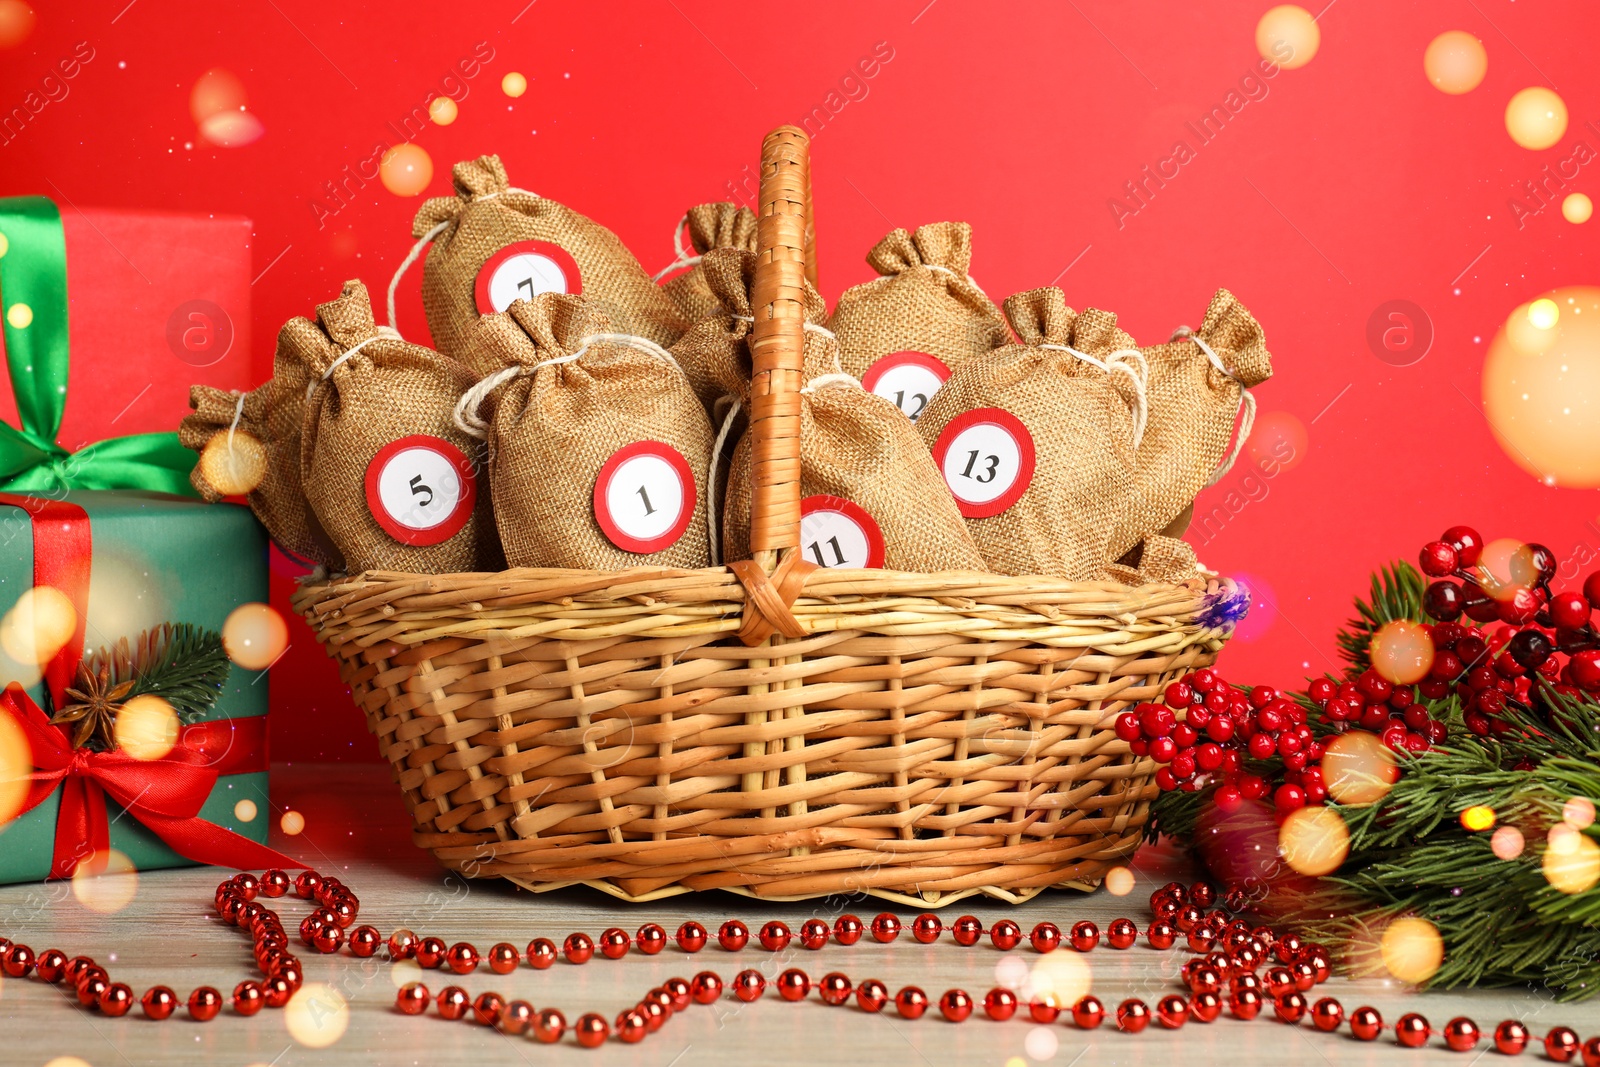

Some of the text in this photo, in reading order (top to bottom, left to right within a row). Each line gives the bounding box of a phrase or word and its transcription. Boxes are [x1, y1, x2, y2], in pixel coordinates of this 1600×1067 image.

[516, 276, 536, 300] 7
[893, 389, 927, 420] 12
[959, 449, 1000, 483] 13
[408, 473, 434, 507] 5
[635, 484, 657, 517] 1
[807, 535, 849, 567] 11
